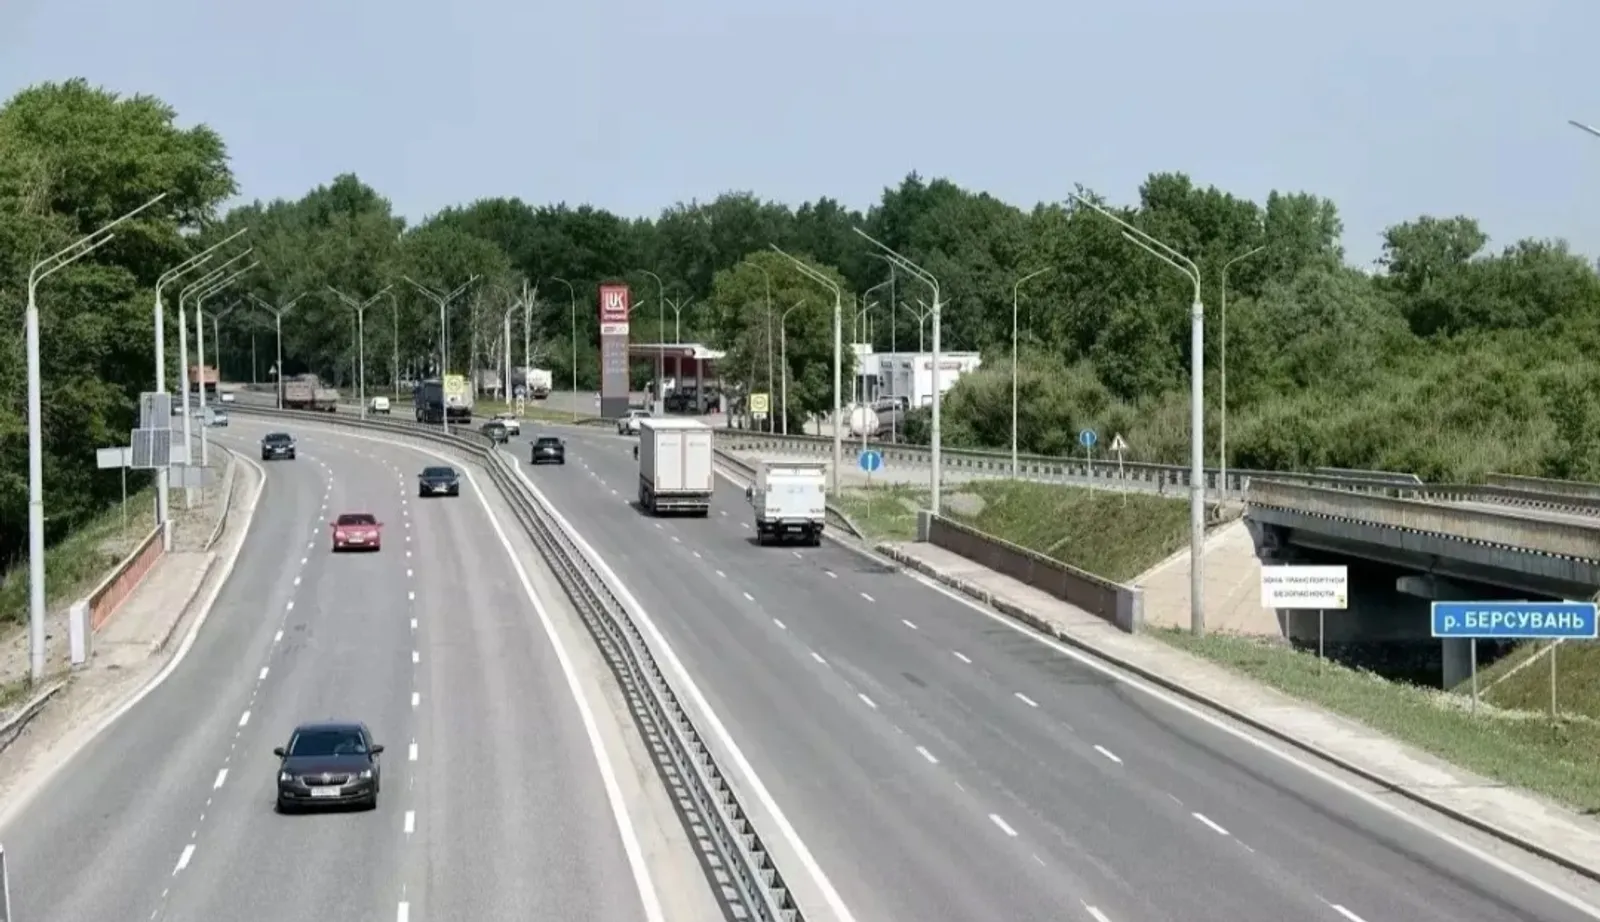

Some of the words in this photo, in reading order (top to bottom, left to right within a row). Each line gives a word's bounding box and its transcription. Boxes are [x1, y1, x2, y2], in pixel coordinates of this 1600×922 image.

[1273, 590, 1335, 598] БЕЗОПАСНОСТИ
[1444, 615, 1461, 632] р.
[1465, 611, 1585, 628] БЕРСУВАНЬ
